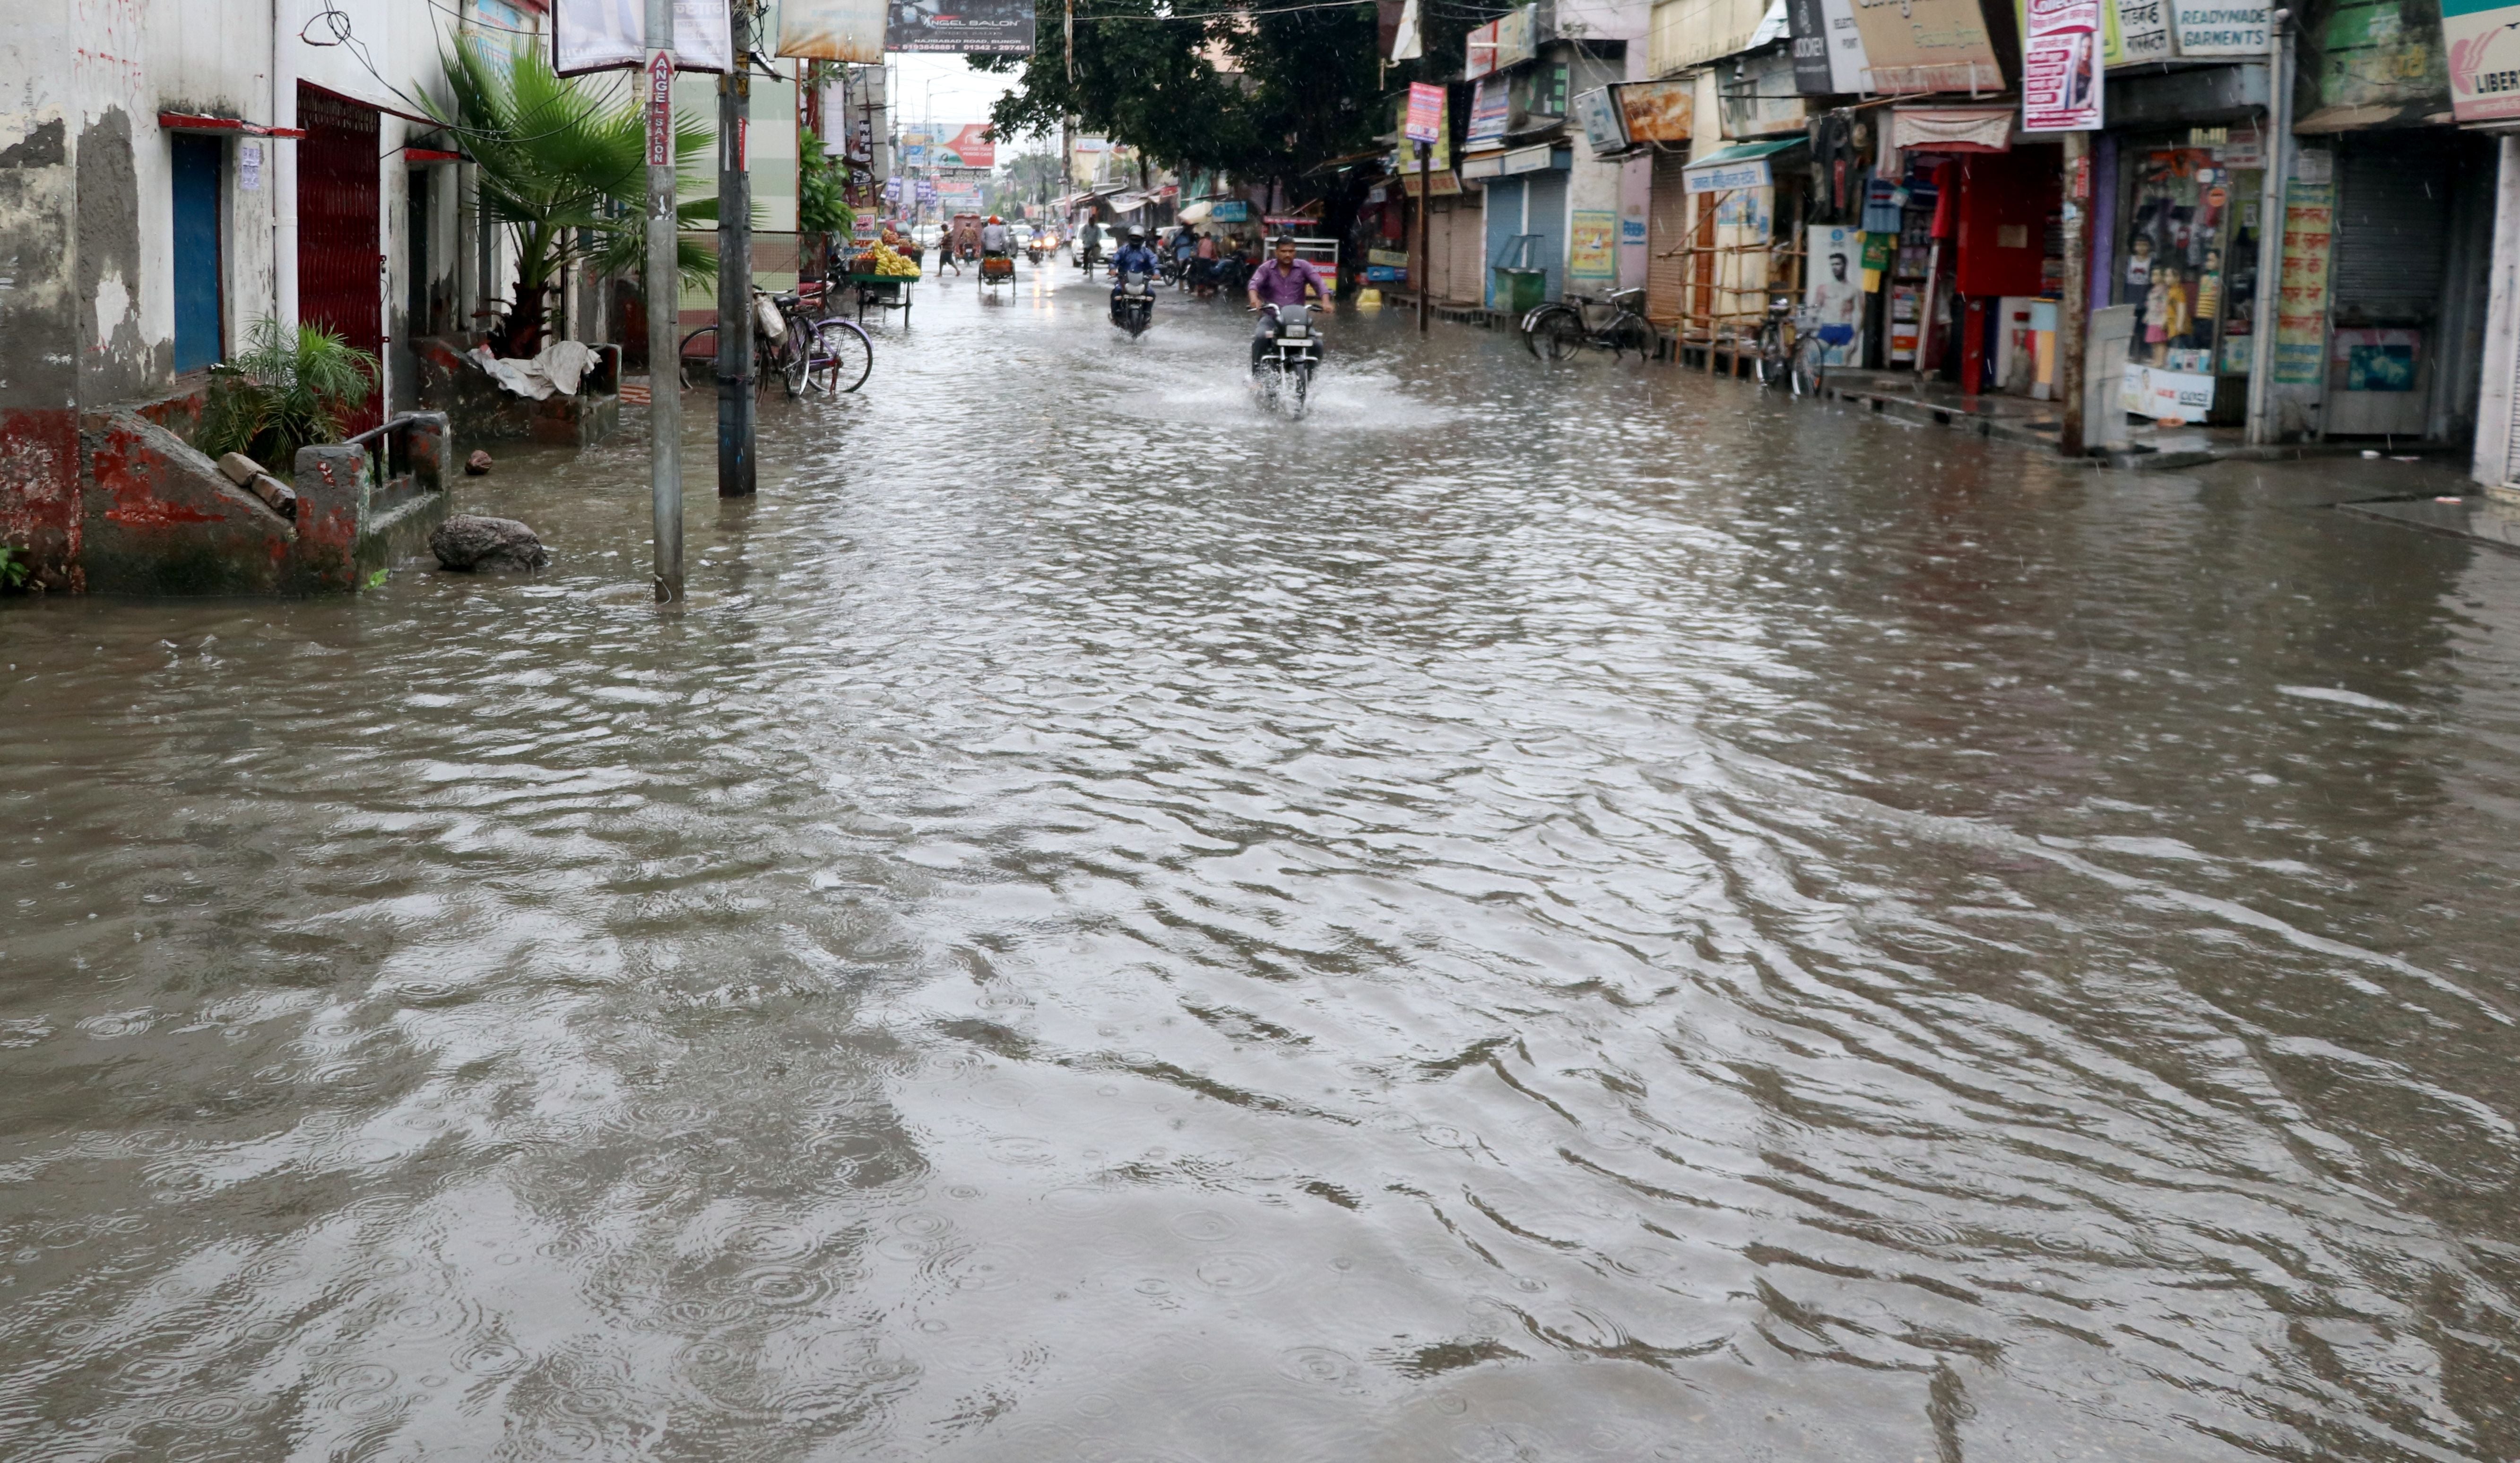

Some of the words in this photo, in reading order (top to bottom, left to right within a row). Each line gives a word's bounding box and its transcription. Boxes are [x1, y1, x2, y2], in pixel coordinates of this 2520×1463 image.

[2181, 9, 2267, 25] READYMADE
[1794, 37, 1824, 57] JOCKEY
[2184, 29, 2264, 46] GARMENTS
[655, 59, 667, 114] ANGEL
[2475, 69, 2520, 93] LIBER
[654, 119, 664, 163] SALON
